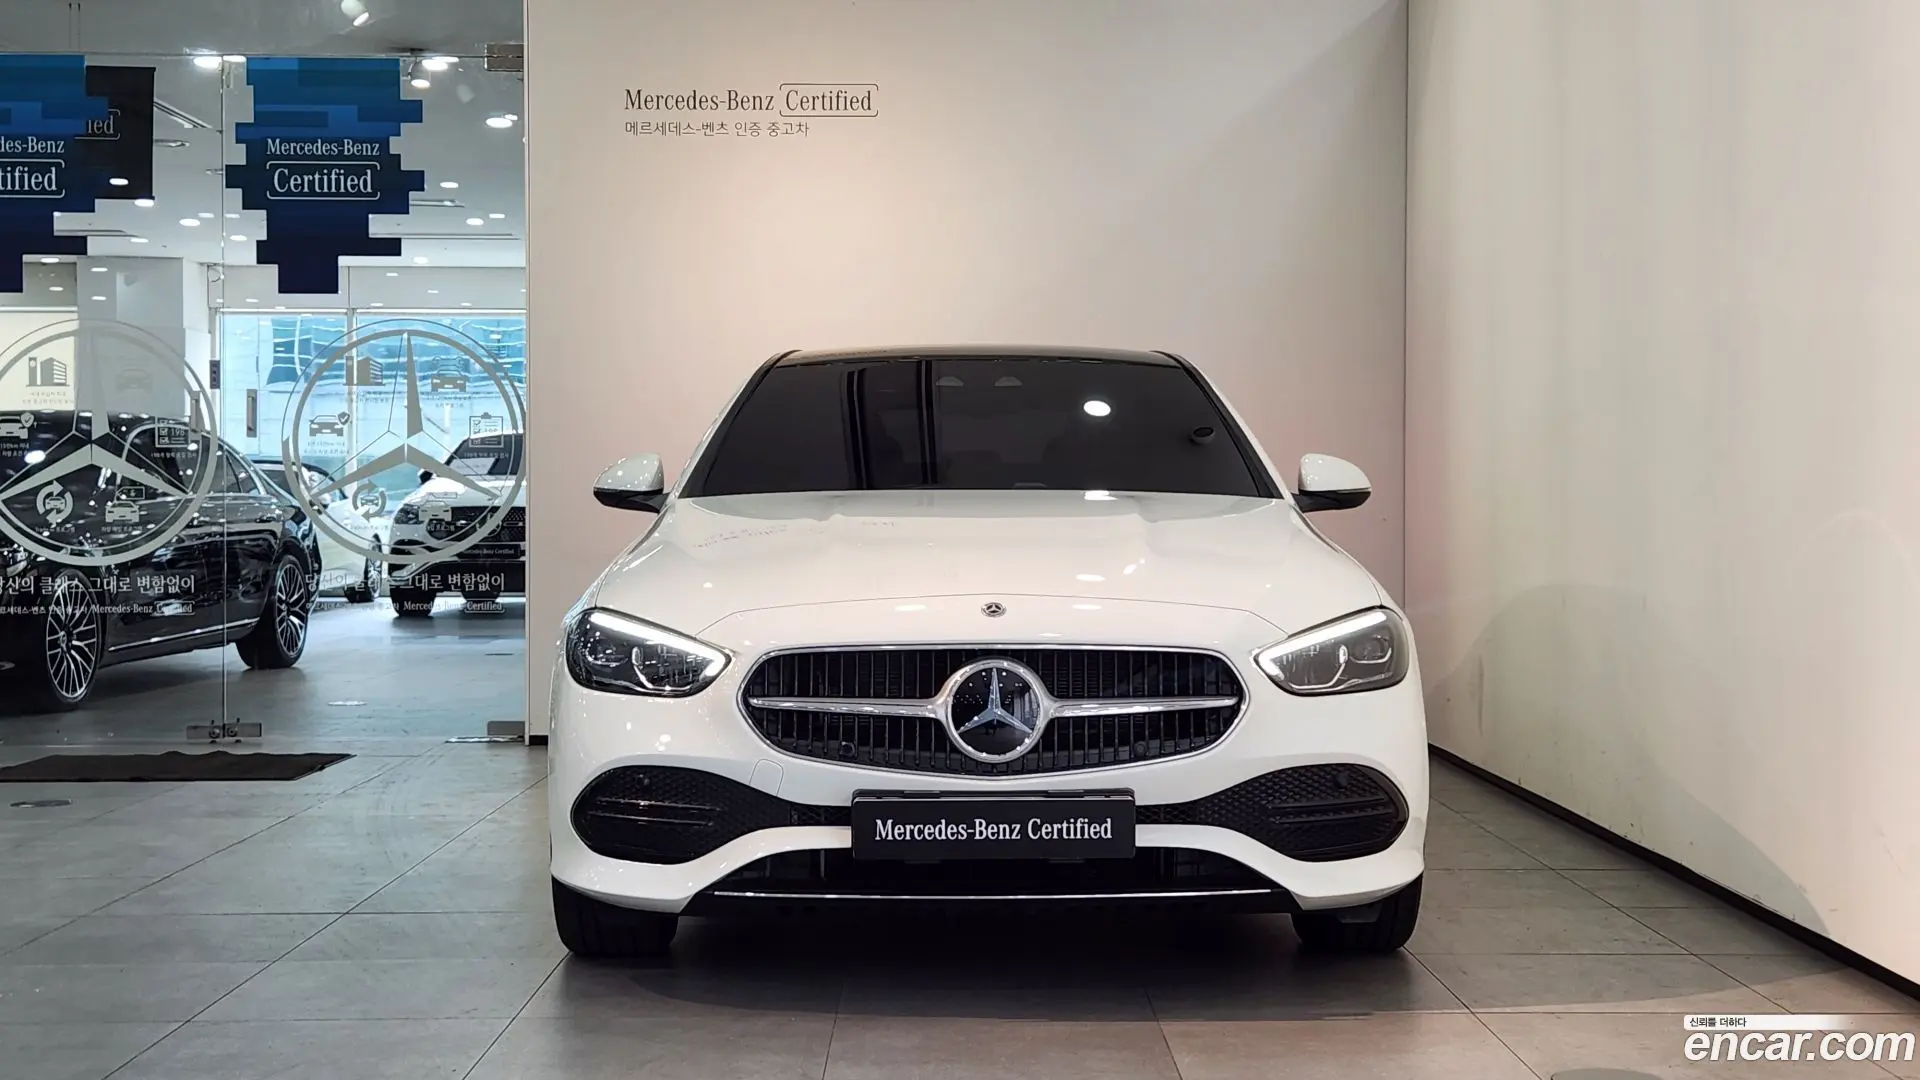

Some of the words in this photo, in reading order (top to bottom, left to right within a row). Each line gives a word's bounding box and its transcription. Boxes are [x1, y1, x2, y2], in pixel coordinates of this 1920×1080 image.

[625, 89, 775, 110] Mercedes-Benz
[786, 90, 871, 111] Certified
[625, 121, 729, 137] 메르세데스-벤츠
[734, 121, 763, 137] 인증
[766, 121, 810, 137] 중고차
[266, 138, 380, 156] Mercedes-Benz
[273, 168, 373, 193] Certified
[88, 576, 133, 594] 그대로
[137, 575, 195, 594] 변함없이
[400, 573, 444, 591] 그대로
[448, 572, 505, 591] 변함없이
[90, 603, 153, 614] Mercedes-Benz
[466, 601, 503, 611] Certified
[875, 819, 1021, 841] Mercedes-Benz
[1027, 818, 1113, 839] Certified
